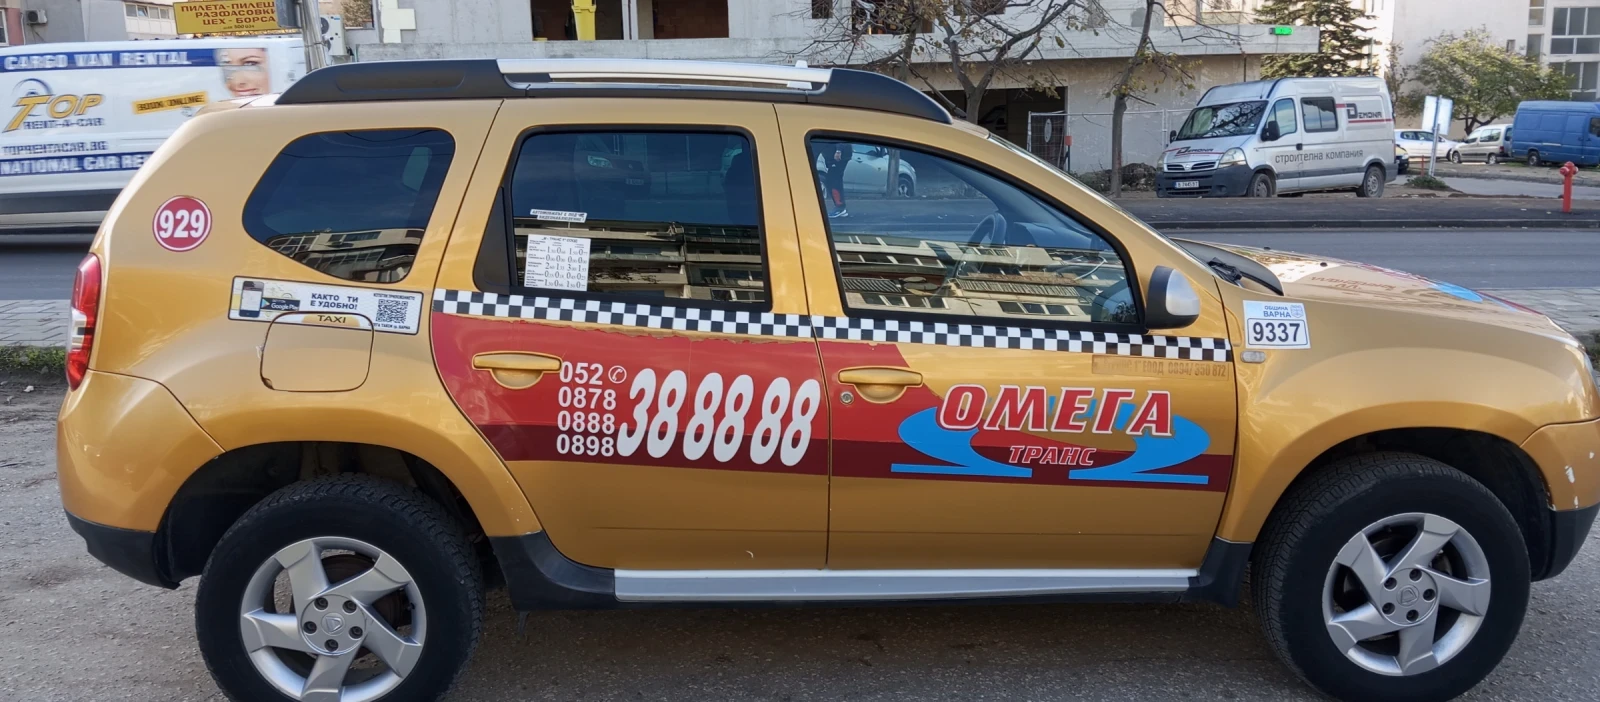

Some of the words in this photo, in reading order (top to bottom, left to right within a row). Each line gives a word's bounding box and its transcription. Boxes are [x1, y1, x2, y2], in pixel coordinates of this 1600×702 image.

[236, 16, 276, 24] БОРСА
[4, 54, 68, 70] CARGO
[74, 53, 113, 67] VAN
[119, 51, 192, 65] RENTAL
[2, 93, 104, 133] TOP
[23, 117, 105, 130] RENT-A-CAR
[2, 141, 108, 156] TOPRENTACAR.BG
[1275, 151, 1323, 165] строителна
[1325, 149, 1364, 160] компания
[0, 157, 82, 174] NATIONAL
[83, 156, 120, 170] CAR
[121, 154, 149, 169] RE
[158, 208, 205, 239] 929
[270, 302, 289, 311] Google
[311, 293, 340, 301] КАКТО
[318, 300, 358, 310] УДОБНО!
[317, 314, 347, 323] TAXI
[1263, 310, 1292, 318] ВАРНА
[1252, 321, 1301, 343] 9337
[559, 361, 604, 385] 052
[1212, 364, 1226, 377] 872
[557, 386, 617, 411] 0878
[939, 383, 1174, 437] ОМЕГА
[557, 410, 616, 435] 0888
[556, 433, 615, 457] 0898
[1008, 445, 1097, 466] ТРАНС
